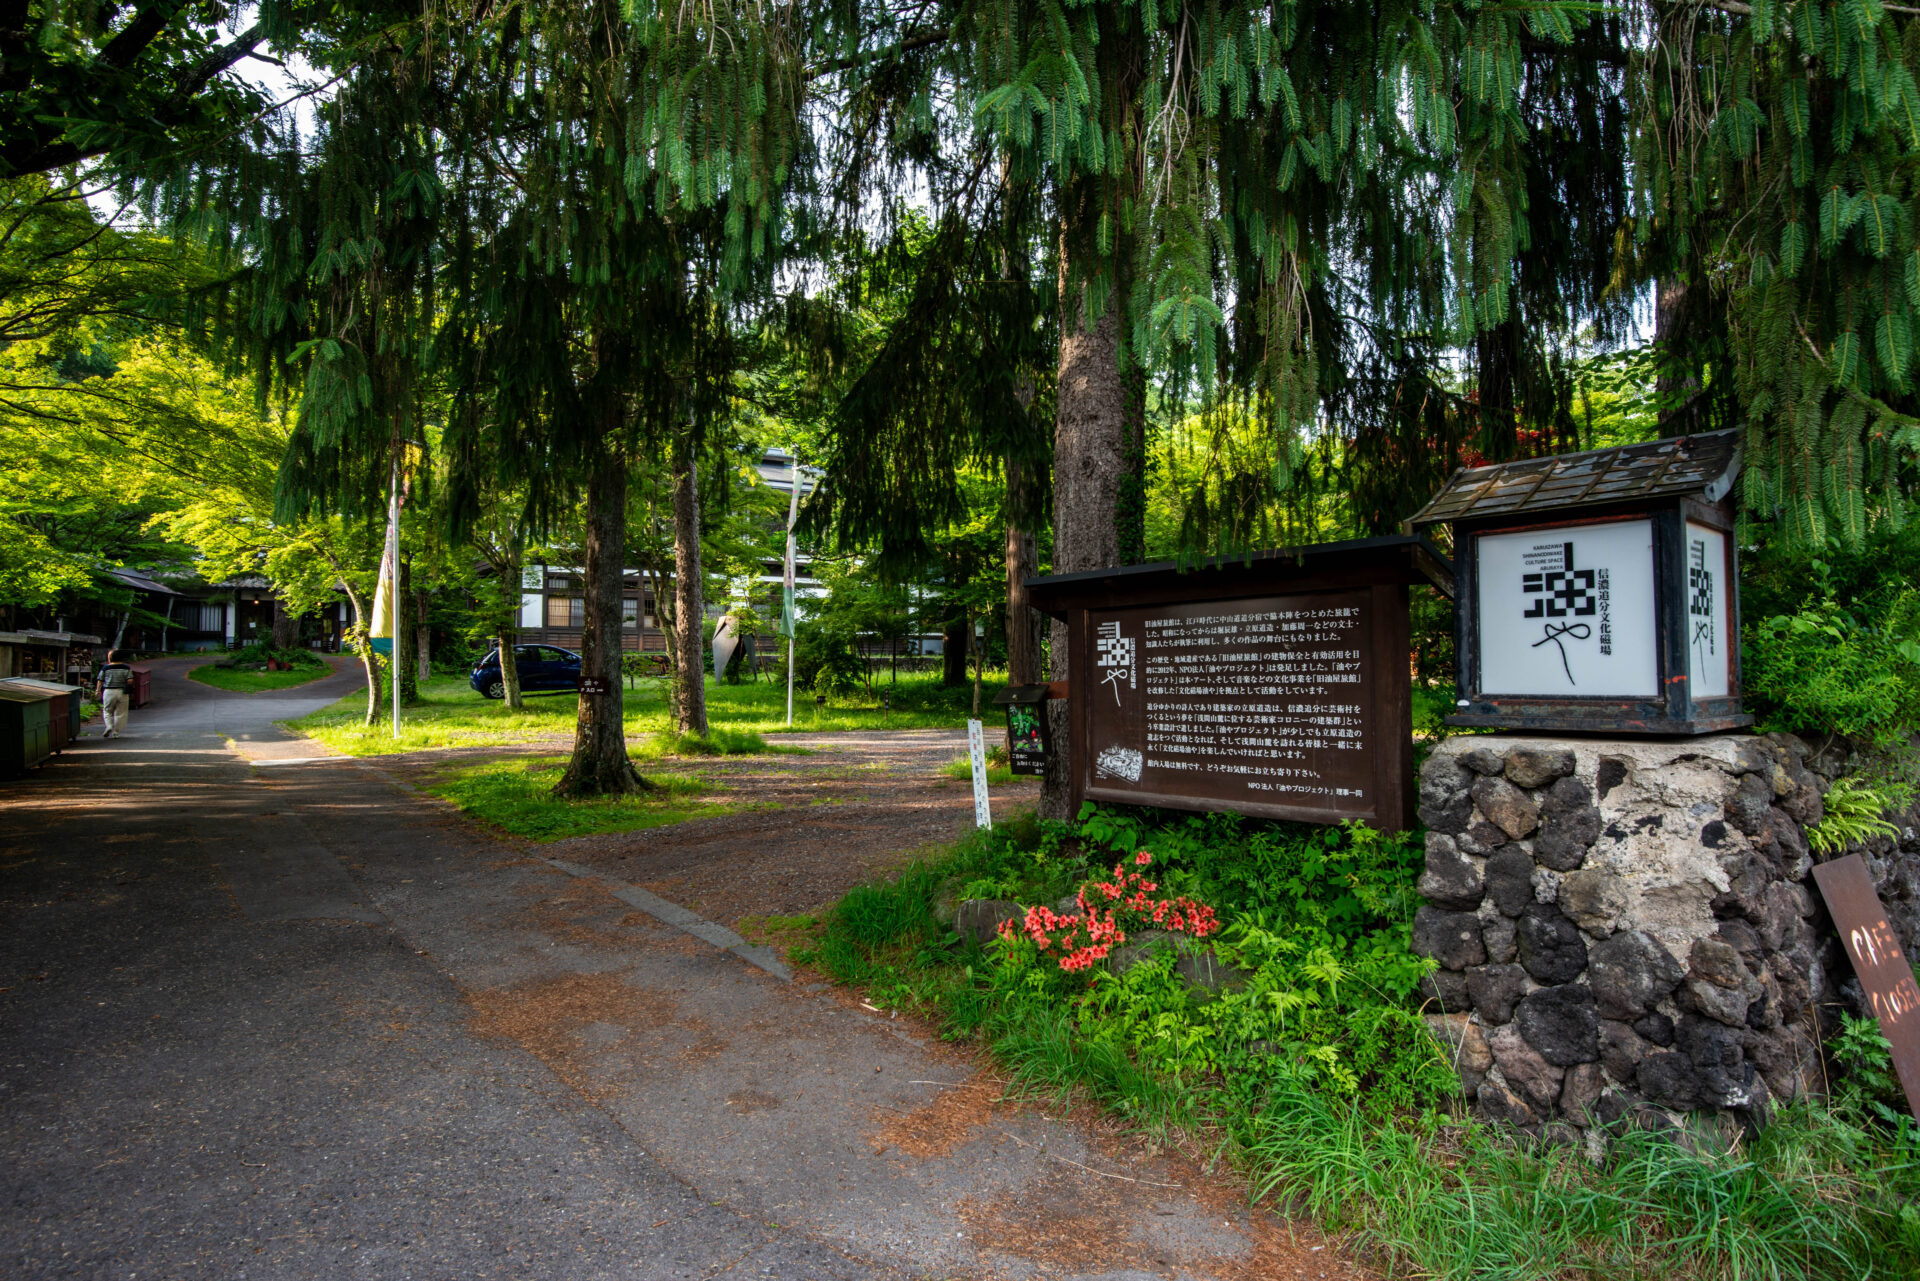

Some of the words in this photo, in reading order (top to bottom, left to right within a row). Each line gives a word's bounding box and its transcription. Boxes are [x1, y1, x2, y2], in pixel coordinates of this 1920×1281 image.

[1598, 568, 1612, 656] 信濃追分文化磁場
